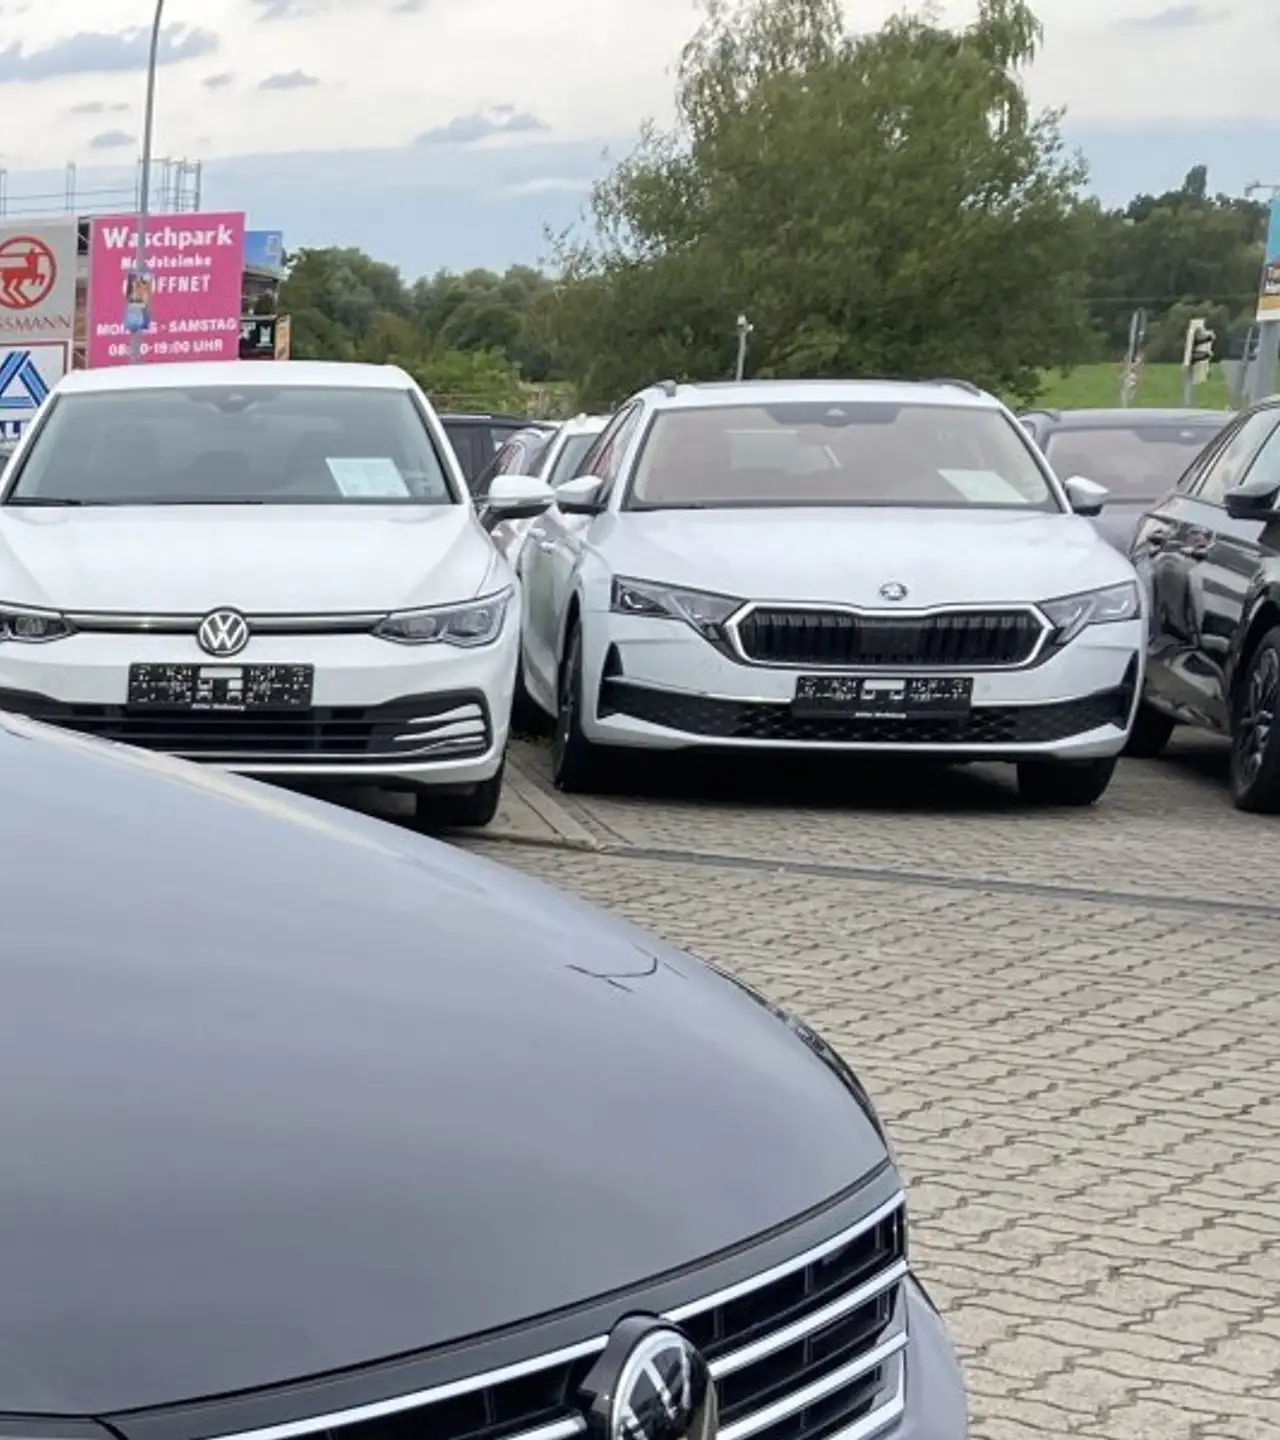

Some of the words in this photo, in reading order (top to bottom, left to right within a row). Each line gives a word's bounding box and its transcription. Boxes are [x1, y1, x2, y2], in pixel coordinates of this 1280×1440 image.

[121, 254, 213, 270] Ndsteimke
[168, 316, 238, 334] SAMSTAG
[192, 338, 224, 353] UHR
